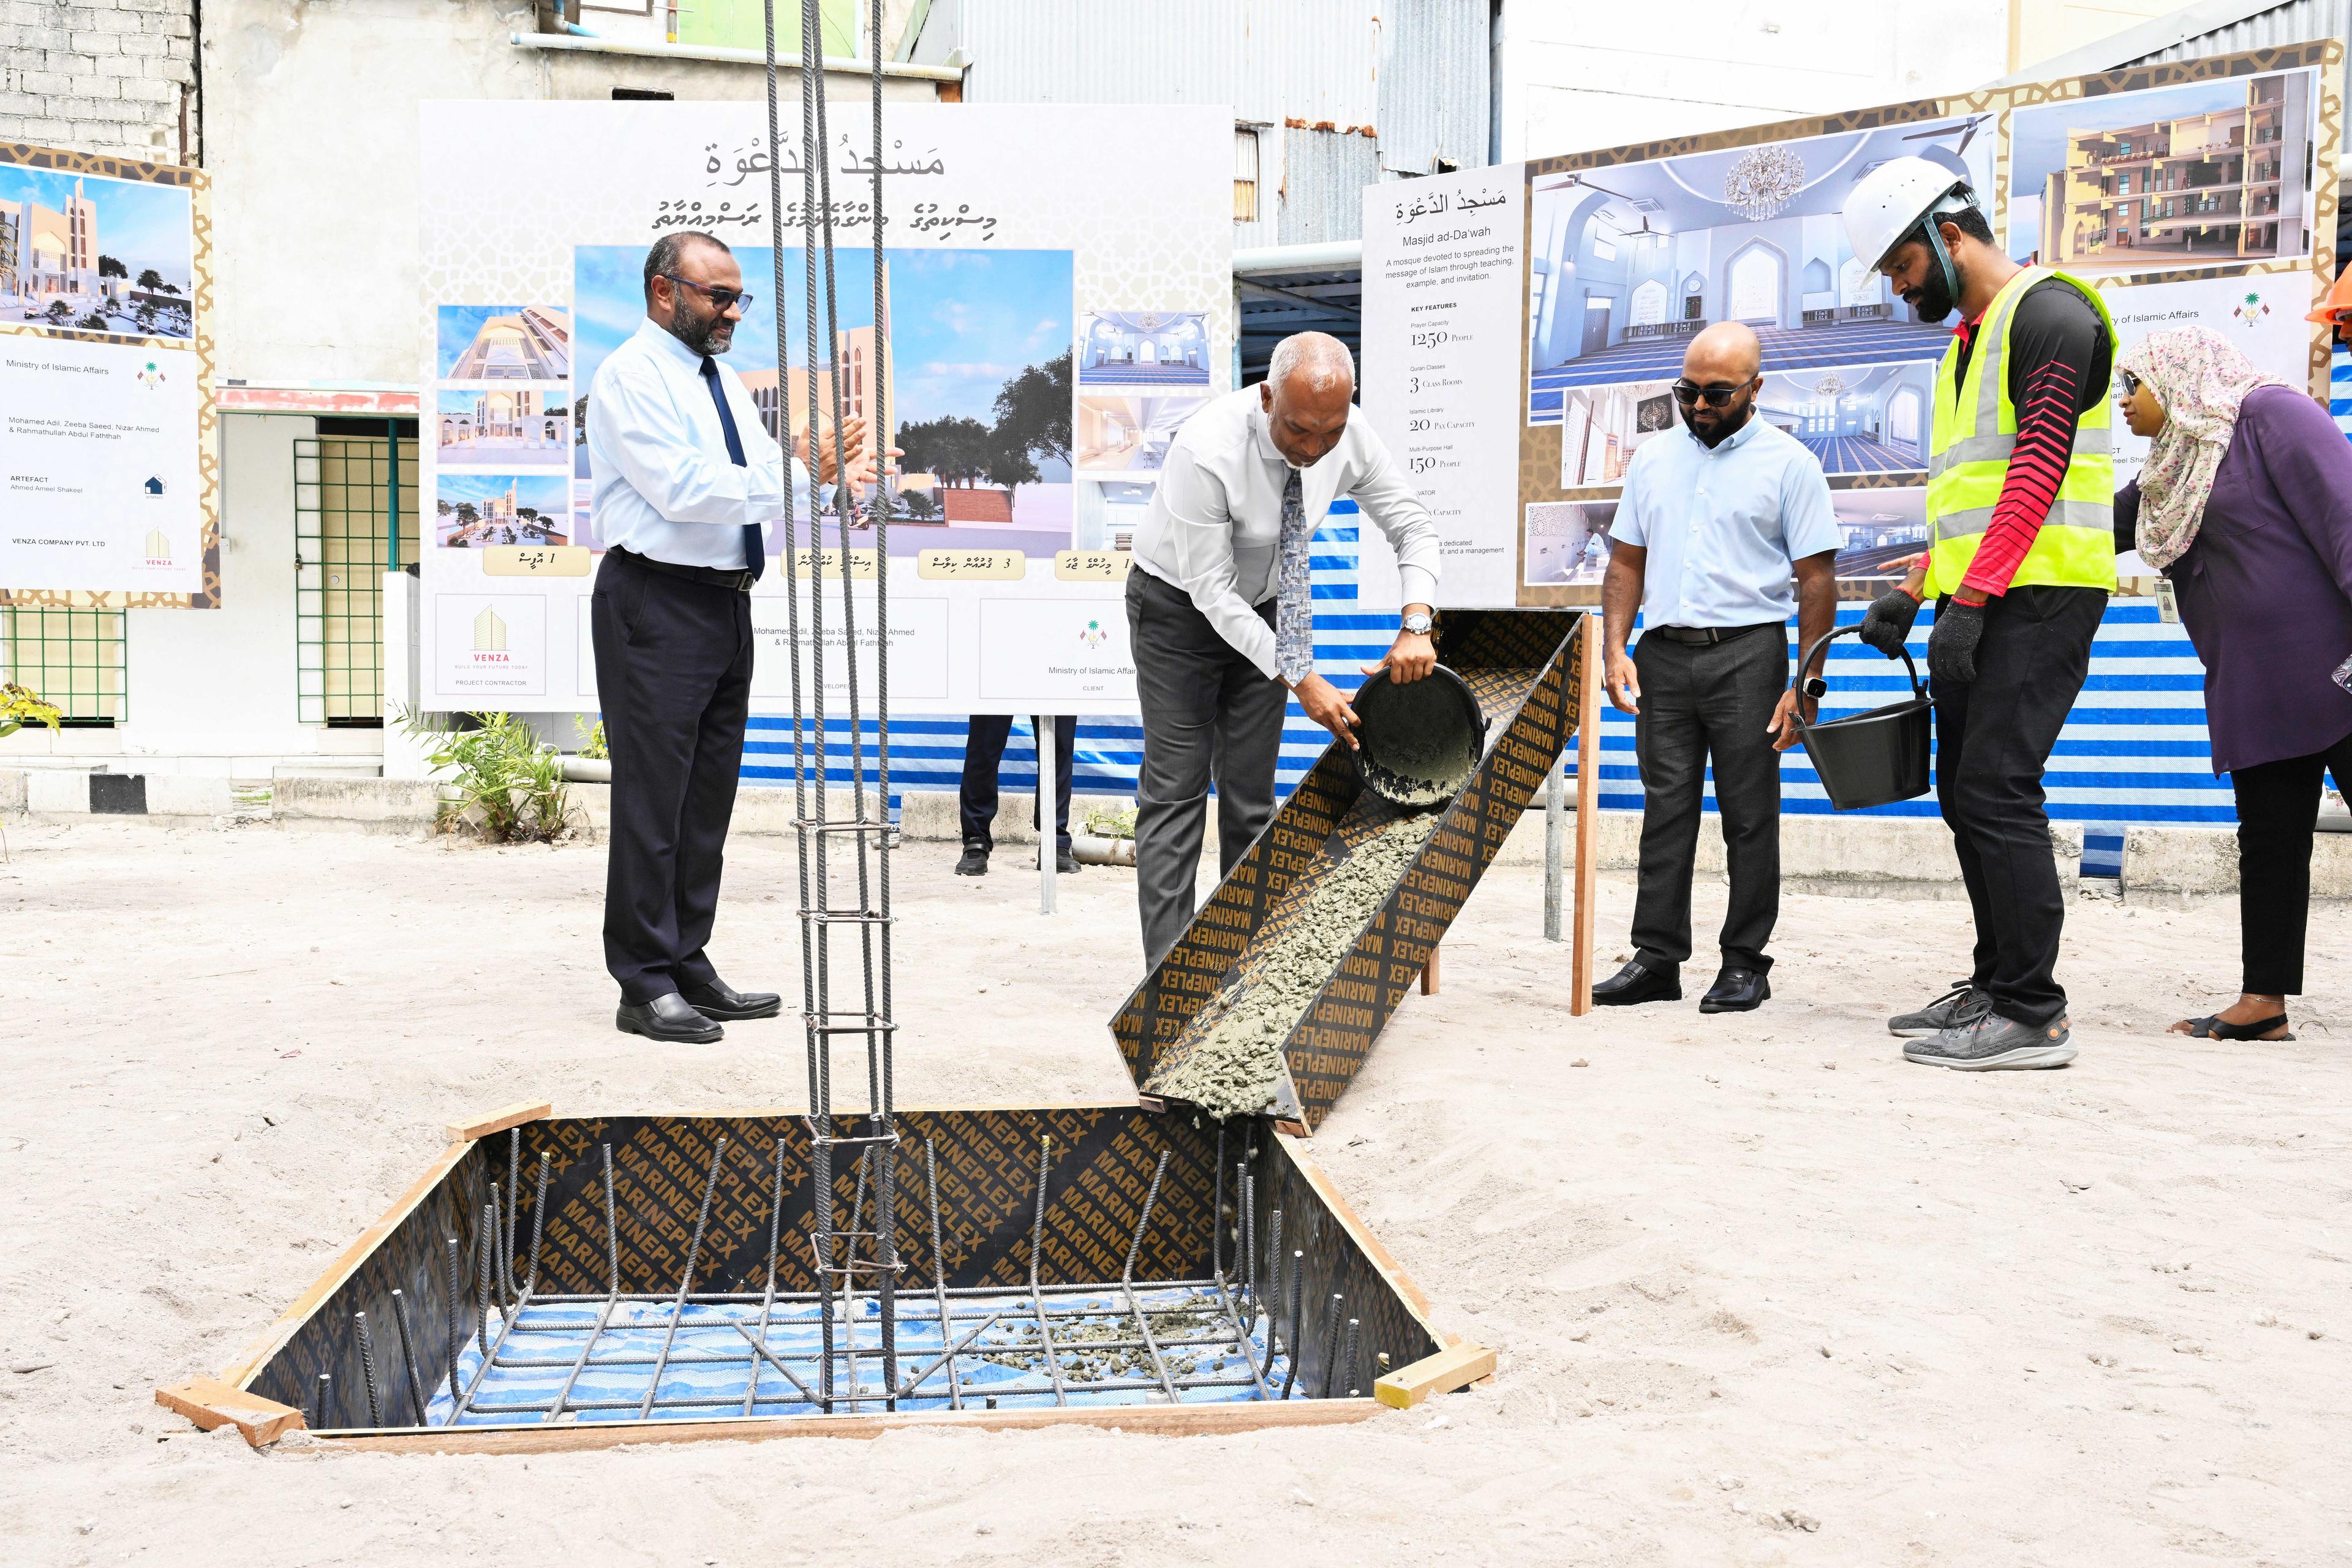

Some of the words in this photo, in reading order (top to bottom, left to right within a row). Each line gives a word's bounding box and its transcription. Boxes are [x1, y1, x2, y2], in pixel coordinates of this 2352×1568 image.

[1403, 233, 1434, 247] Masjid
[1393, 257, 1422, 266] mosque
[1423, 252, 1453, 263] devoted
[1463, 246, 1500, 258] spreading
[1385, 268, 1418, 279] message
[1420, 266, 1428, 275] of
[1428, 265, 1448, 274] Islam
[1450, 260, 1478, 271] through
[1480, 256, 1514, 267] teaching,
[1406, 278, 1439, 289] example,
[1441, 276, 1455, 285] and
[1457, 272, 1492, 282] invitation.
[1425, 302, 1458, 311] FEATURES
[2121, 315, 2131, 324] of
[2133, 312, 2166, 323] Islamic
[2168, 310, 2199, 319] Affairs
[1411, 331, 1448, 350] 1250
[6, 360, 39, 371] Ministry
[52, 363, 81, 373] Islamic
[83, 366, 110, 375] Affairs
[1410, 377, 1419, 394] 3
[9, 417, 45, 425] Mohamed
[89, 421, 114, 431] Saeed,
[1409, 419, 1431, 432] 20
[17, 427, 67, 437] Rahmathullah
[1408, 456, 1436, 475] 150
[1003, 558, 1011, 569] 3
[838, 628, 864, 637] Saed,
